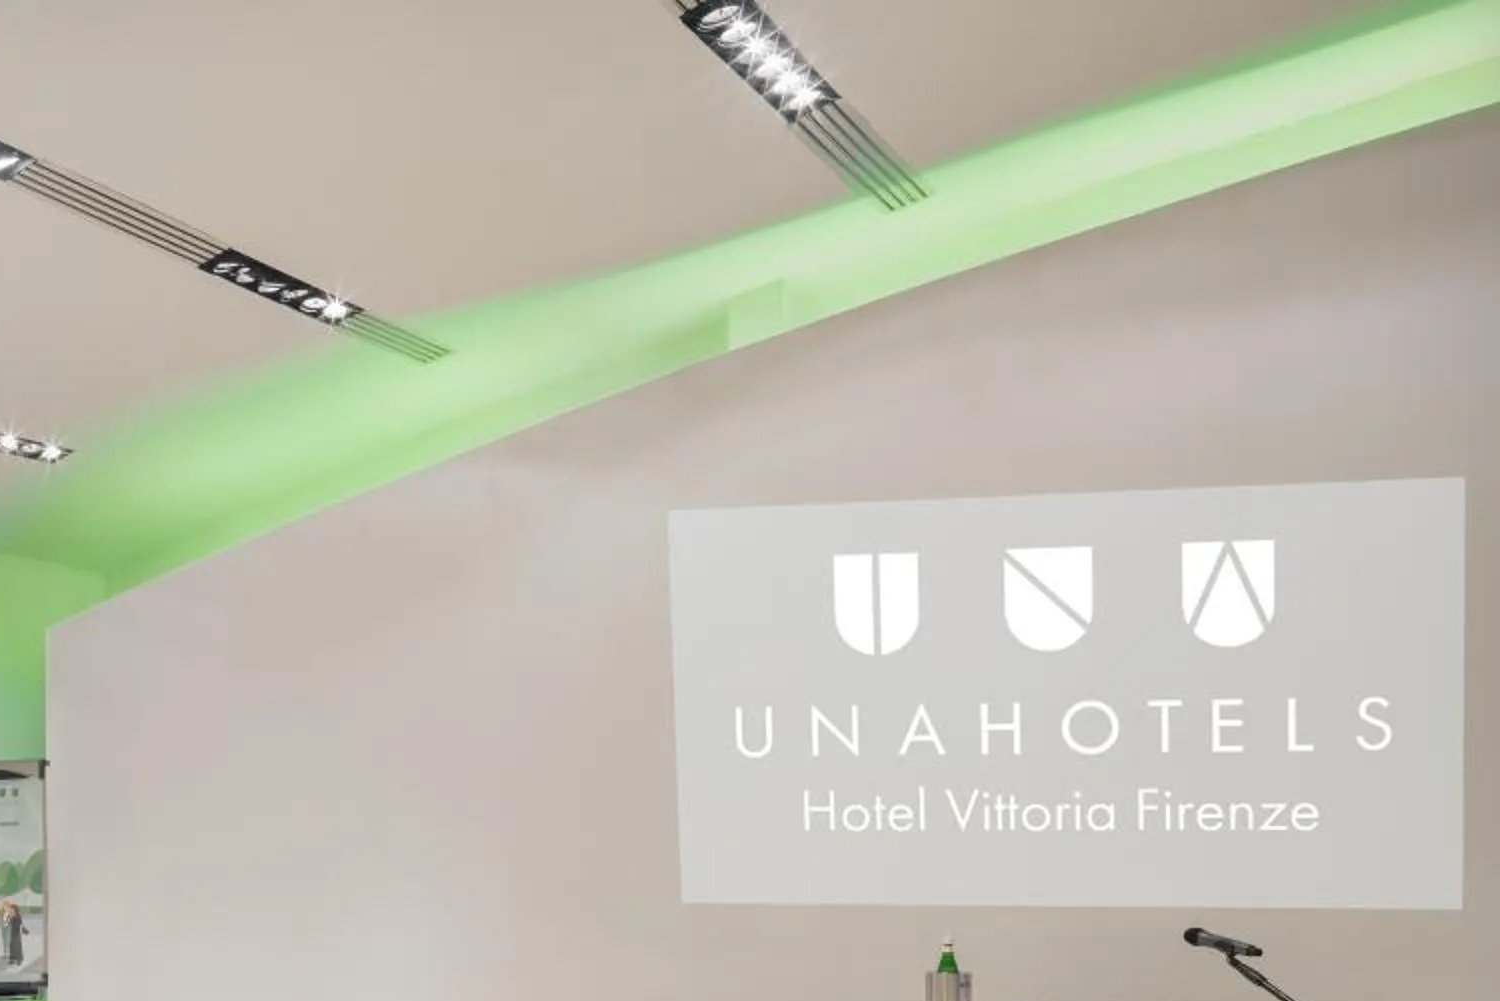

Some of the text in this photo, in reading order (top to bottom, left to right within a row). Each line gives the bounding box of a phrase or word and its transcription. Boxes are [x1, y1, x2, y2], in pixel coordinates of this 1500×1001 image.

[733, 696, 1394, 759] UNAHOTELS
[802, 785, 1321, 833] Hotel Vittoria Firenze
